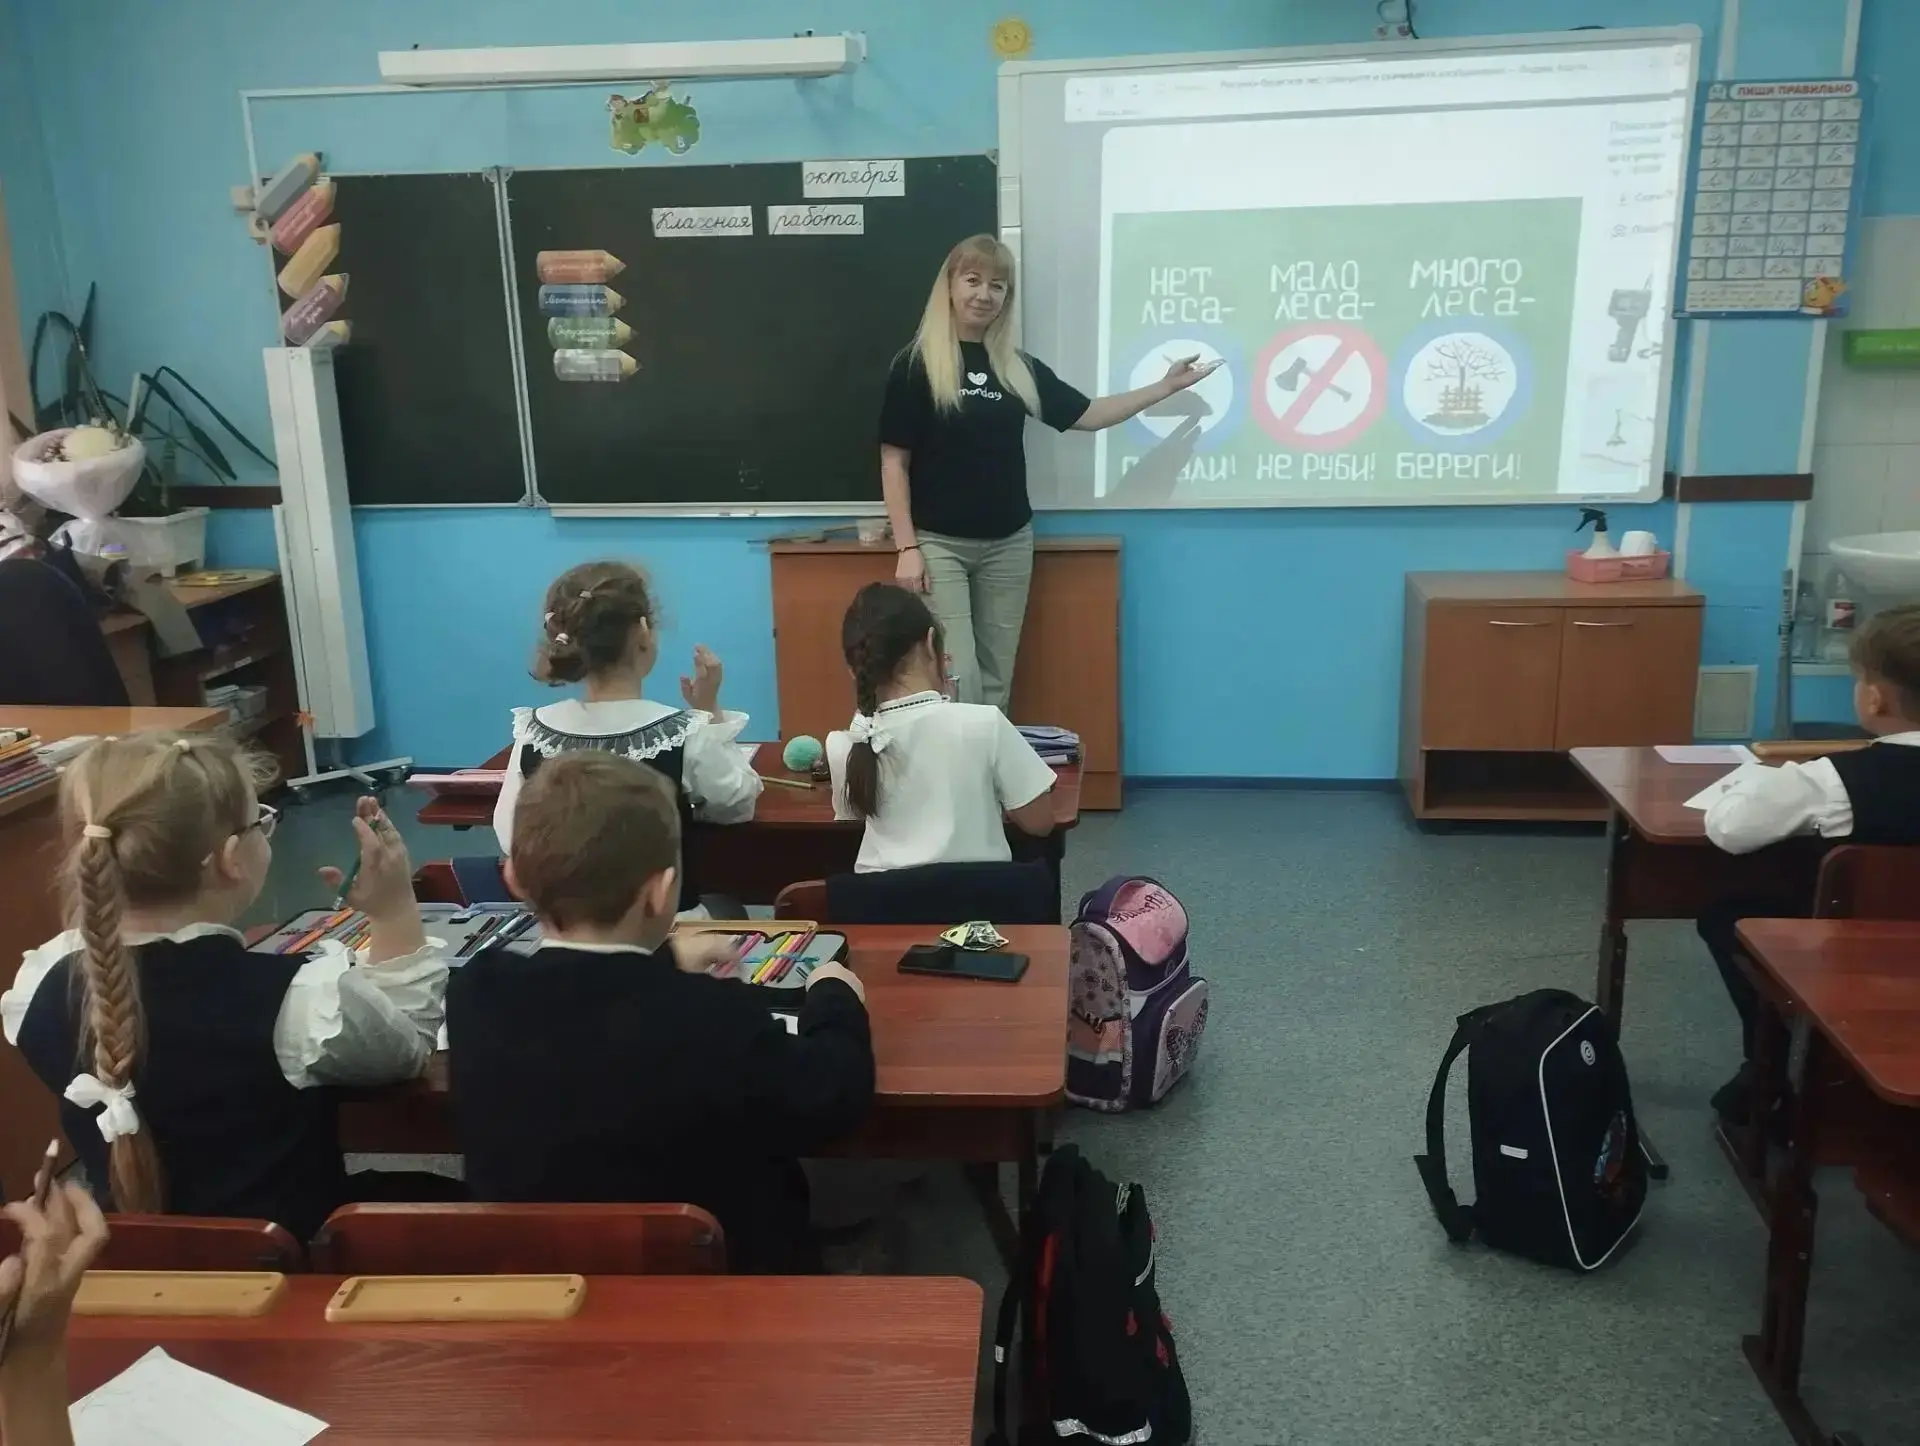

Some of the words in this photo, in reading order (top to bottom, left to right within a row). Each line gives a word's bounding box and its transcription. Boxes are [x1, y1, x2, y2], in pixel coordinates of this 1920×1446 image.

[1738, 86, 1774, 96] ПИШИ
[1778, 83, 1853, 95] ПРАВИЛЬНО
[655, 211, 751, 231] Классная
[959, 386, 1003, 401] monday
